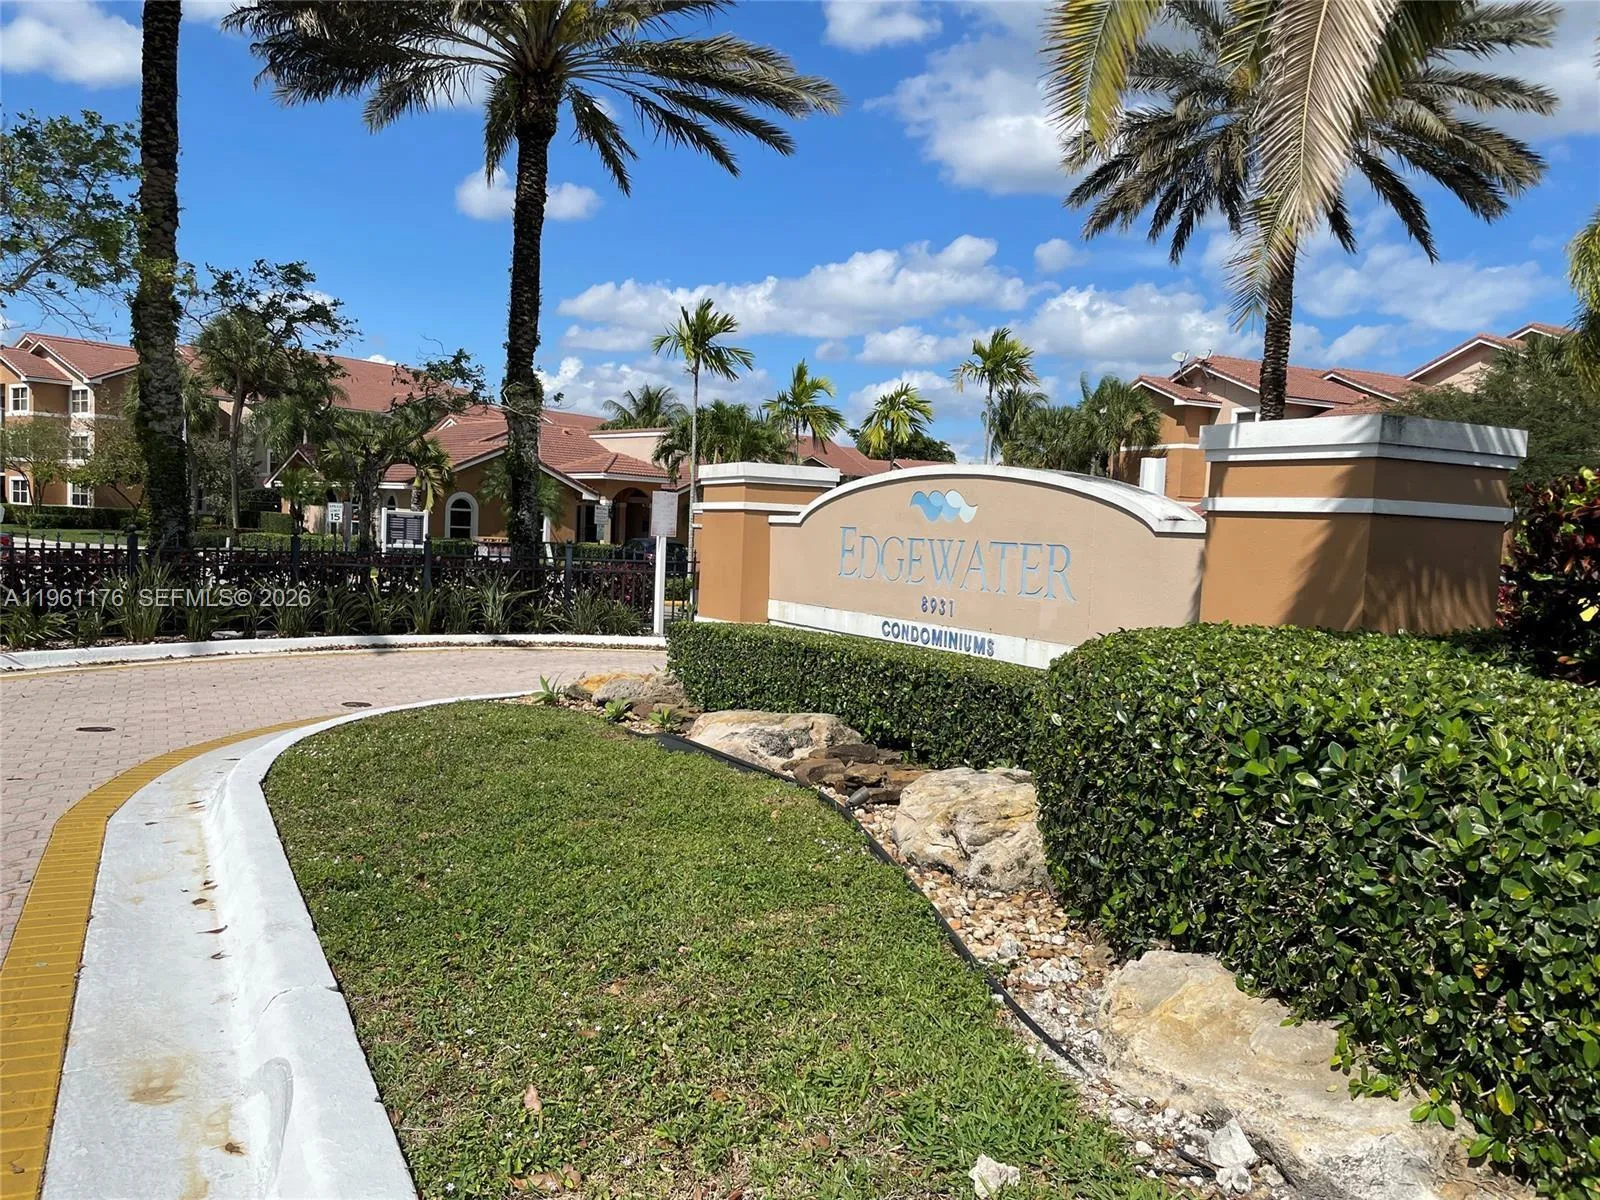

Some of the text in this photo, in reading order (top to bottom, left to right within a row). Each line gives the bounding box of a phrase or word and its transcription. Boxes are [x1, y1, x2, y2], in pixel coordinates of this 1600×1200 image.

[330, 512, 341, 521] 15
[838, 526, 1078, 604] EDGEWATER
[921, 595, 953, 617] 8931
[881, 620, 995, 657] CONDOMINIUMS
